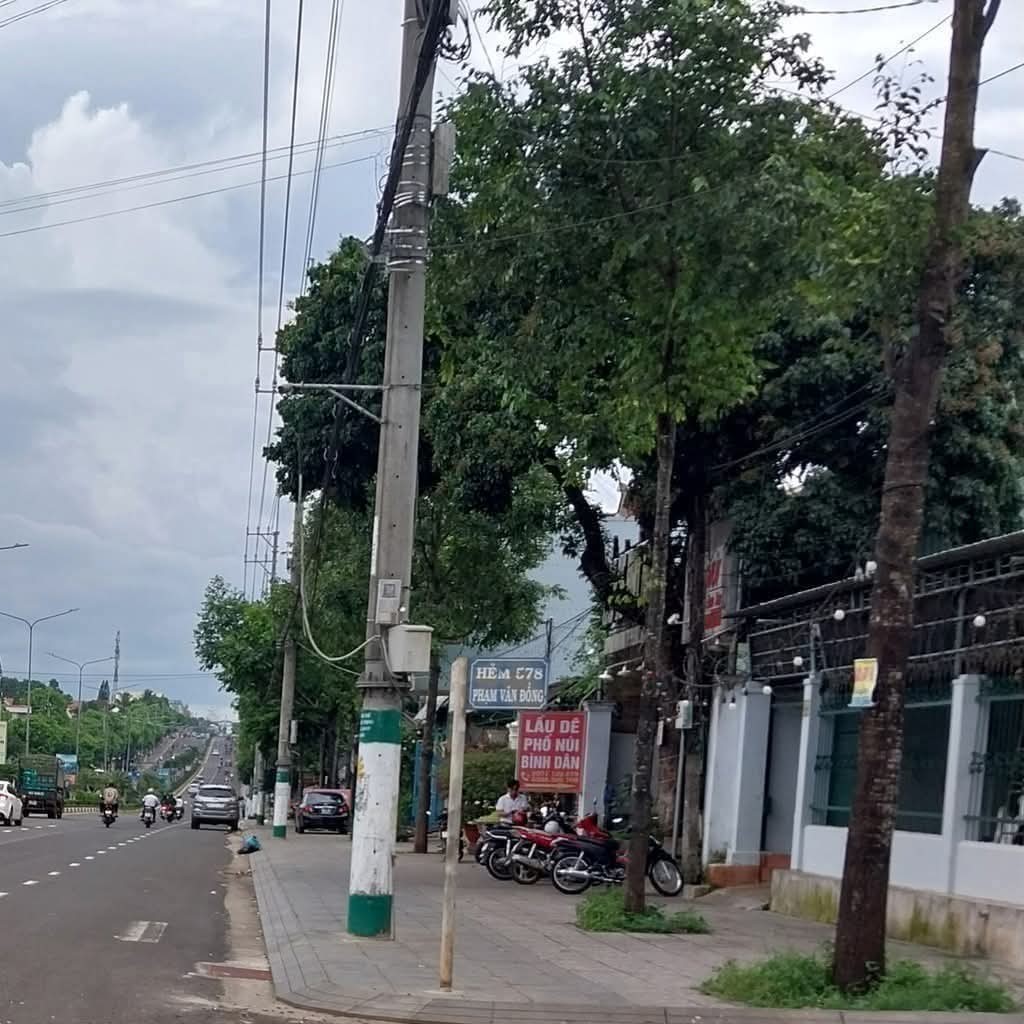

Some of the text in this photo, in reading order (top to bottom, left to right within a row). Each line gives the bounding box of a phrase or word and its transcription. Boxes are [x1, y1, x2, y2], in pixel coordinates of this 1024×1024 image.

[472, 681, 545, 705] PHẠM VĂN ĐỒNG
[523, 733, 580, 753] PHỐ NÚI
[521, 752, 580, 770] BÌNH DÂN
